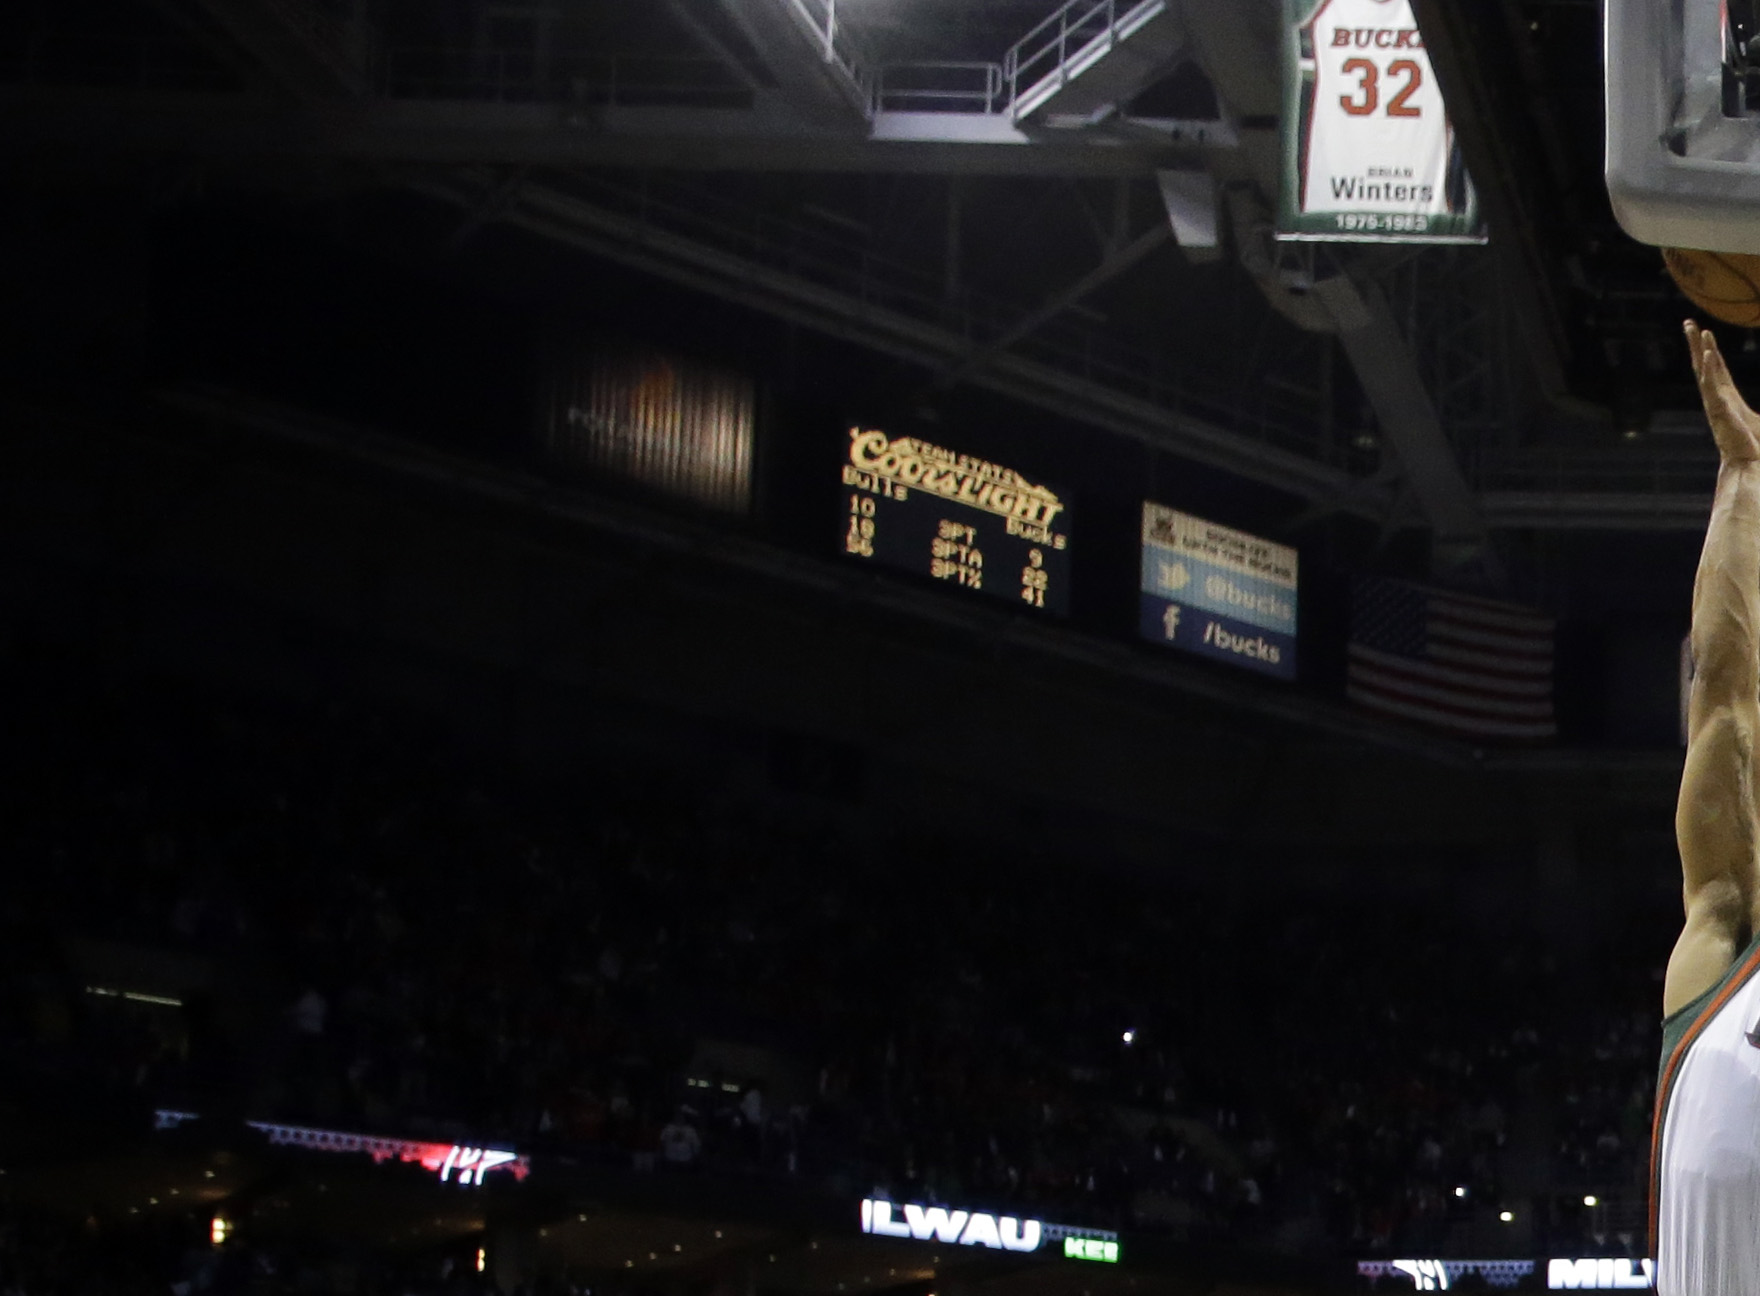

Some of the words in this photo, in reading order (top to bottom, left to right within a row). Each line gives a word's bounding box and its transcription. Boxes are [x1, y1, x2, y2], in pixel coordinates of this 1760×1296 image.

[1331, 28, 1426, 49] BUCK
[1339, 58, 1422, 117] 32
[1331, 176, 1433, 202] Winters
[1203, 621, 1280, 664] /bucks
[1548, 1259, 1653, 1289] MIL
